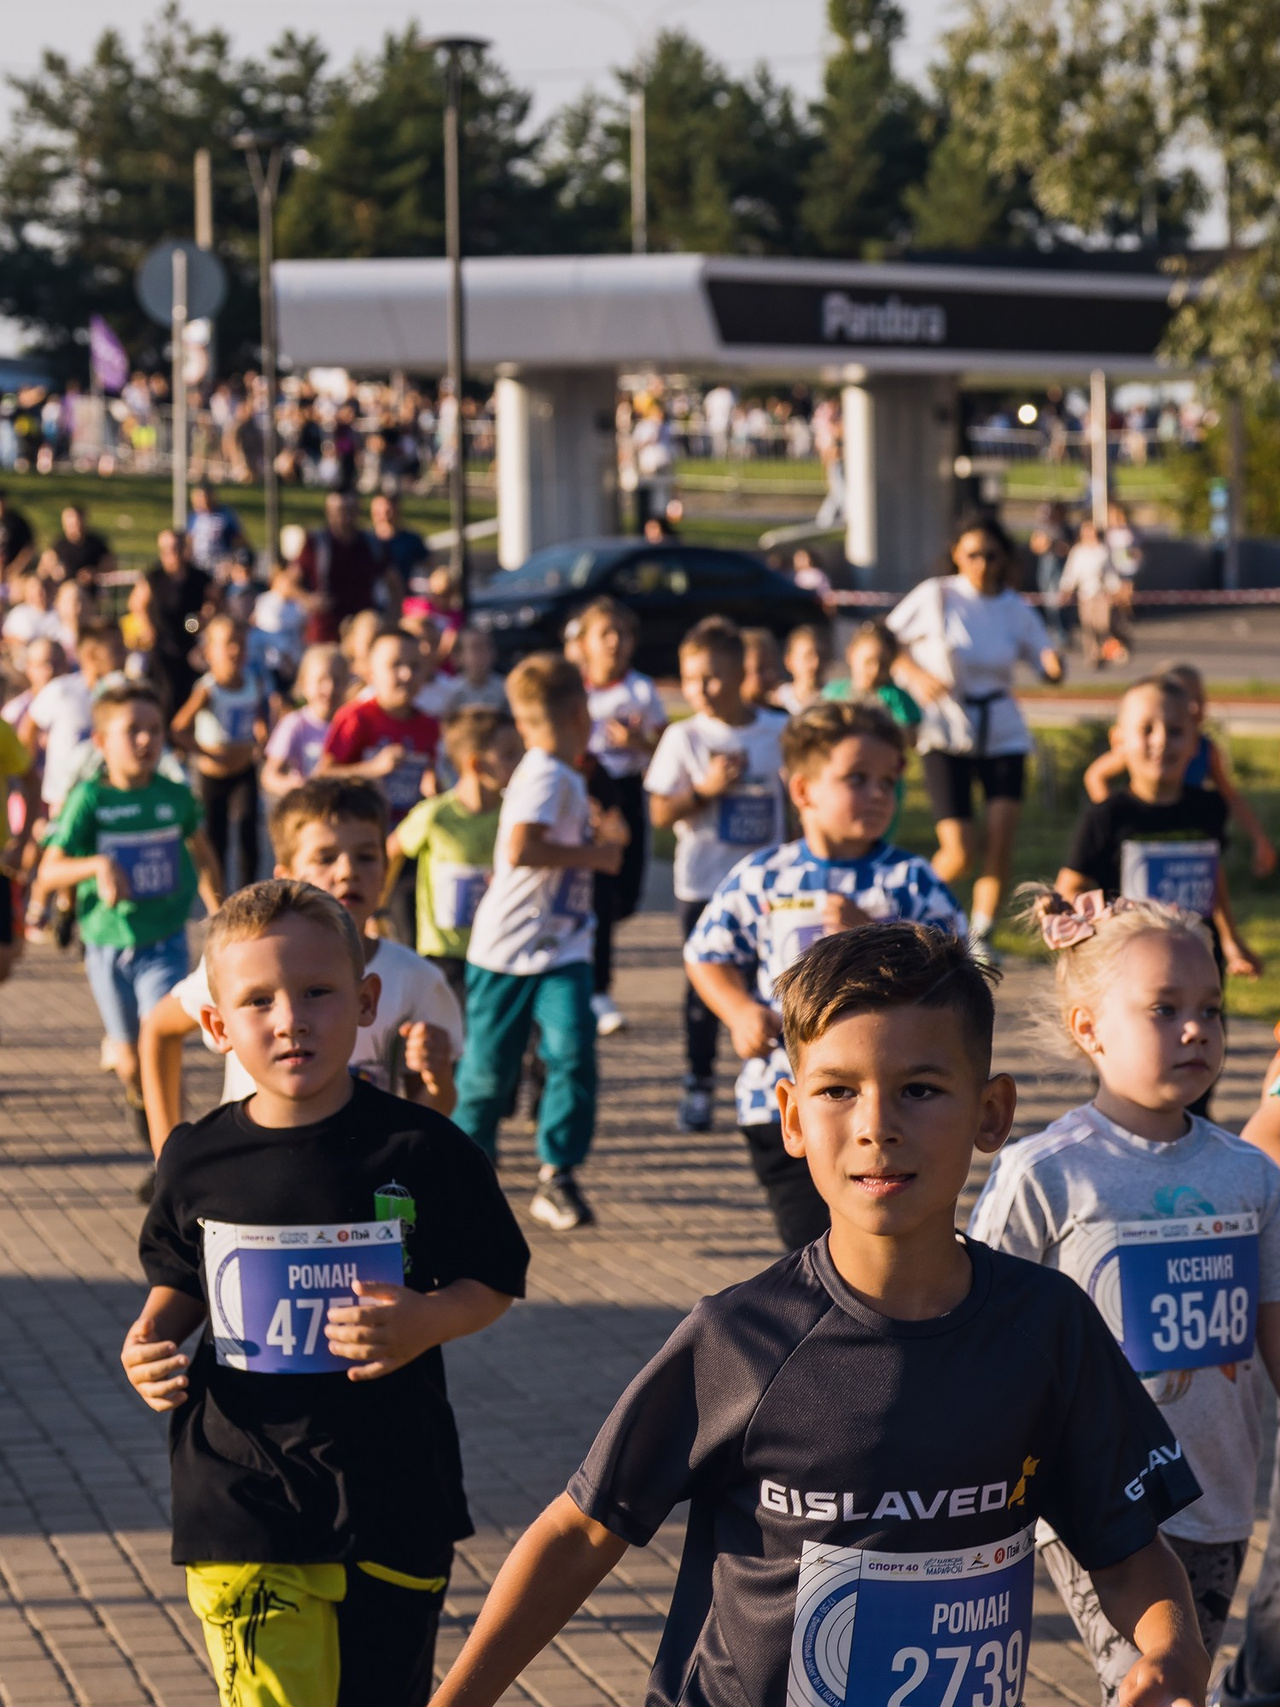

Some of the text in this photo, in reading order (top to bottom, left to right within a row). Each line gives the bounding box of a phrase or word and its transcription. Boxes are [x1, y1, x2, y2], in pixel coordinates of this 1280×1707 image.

[822, 291, 947, 341] Pandora
[132, 861, 174, 894] 931
[351, 1229, 370, 1241] Пэй
[288, 1263, 357, 1290] РОМАН
[1167, 1254, 1234, 1284] КСЕНИЯ
[266, 1296, 385, 1356] 47
[1151, 1286, 1249, 1352] 3548
[760, 1479, 1008, 1521] GISLAVED
[868, 1562, 919, 1572] СПОРТ 40
[1006, 1541, 1021, 1560] Пэй
[932, 1590, 1010, 1635] РОМАН
[887, 1630, 1023, 1707] 2739
